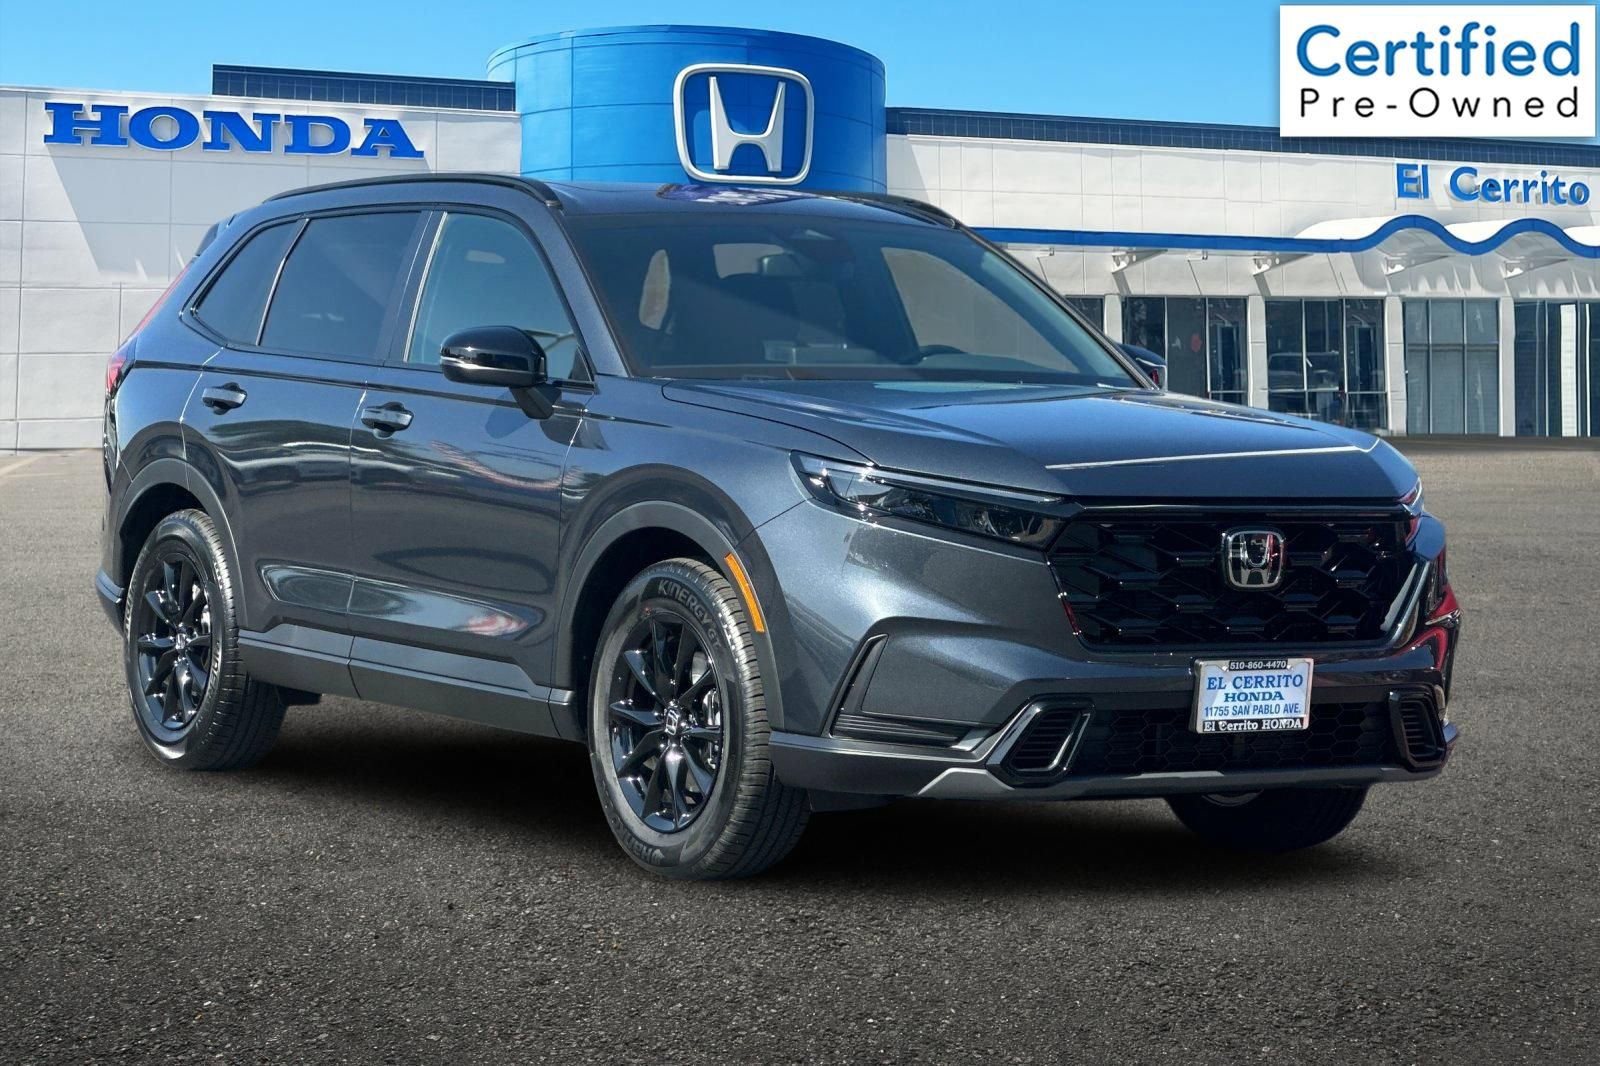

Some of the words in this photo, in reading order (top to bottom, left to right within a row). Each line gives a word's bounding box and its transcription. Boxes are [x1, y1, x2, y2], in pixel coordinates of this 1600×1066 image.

[43, 101, 425, 159] HONDA
[1395, 162, 1429, 200] El
[1449, 166, 1591, 206] Cerrito
[1229, 660, 1287, 671] 510-860-4470
[1206, 676, 1227, 690] EL
[1232, 674, 1304, 690] CERRITO
[1224, 691, 1285, 702] HONDA
[1204, 706, 1230, 717] 11755
[1231, 705, 1250, 716] SAN
[1252, 703, 1281, 715] PABLO
[1283, 702, 1301, 714] AVE.
[1203, 720, 1216, 732] El
[1219, 719, 1259, 732] Cerrito
[1262, 717, 1302, 730] HONDA
